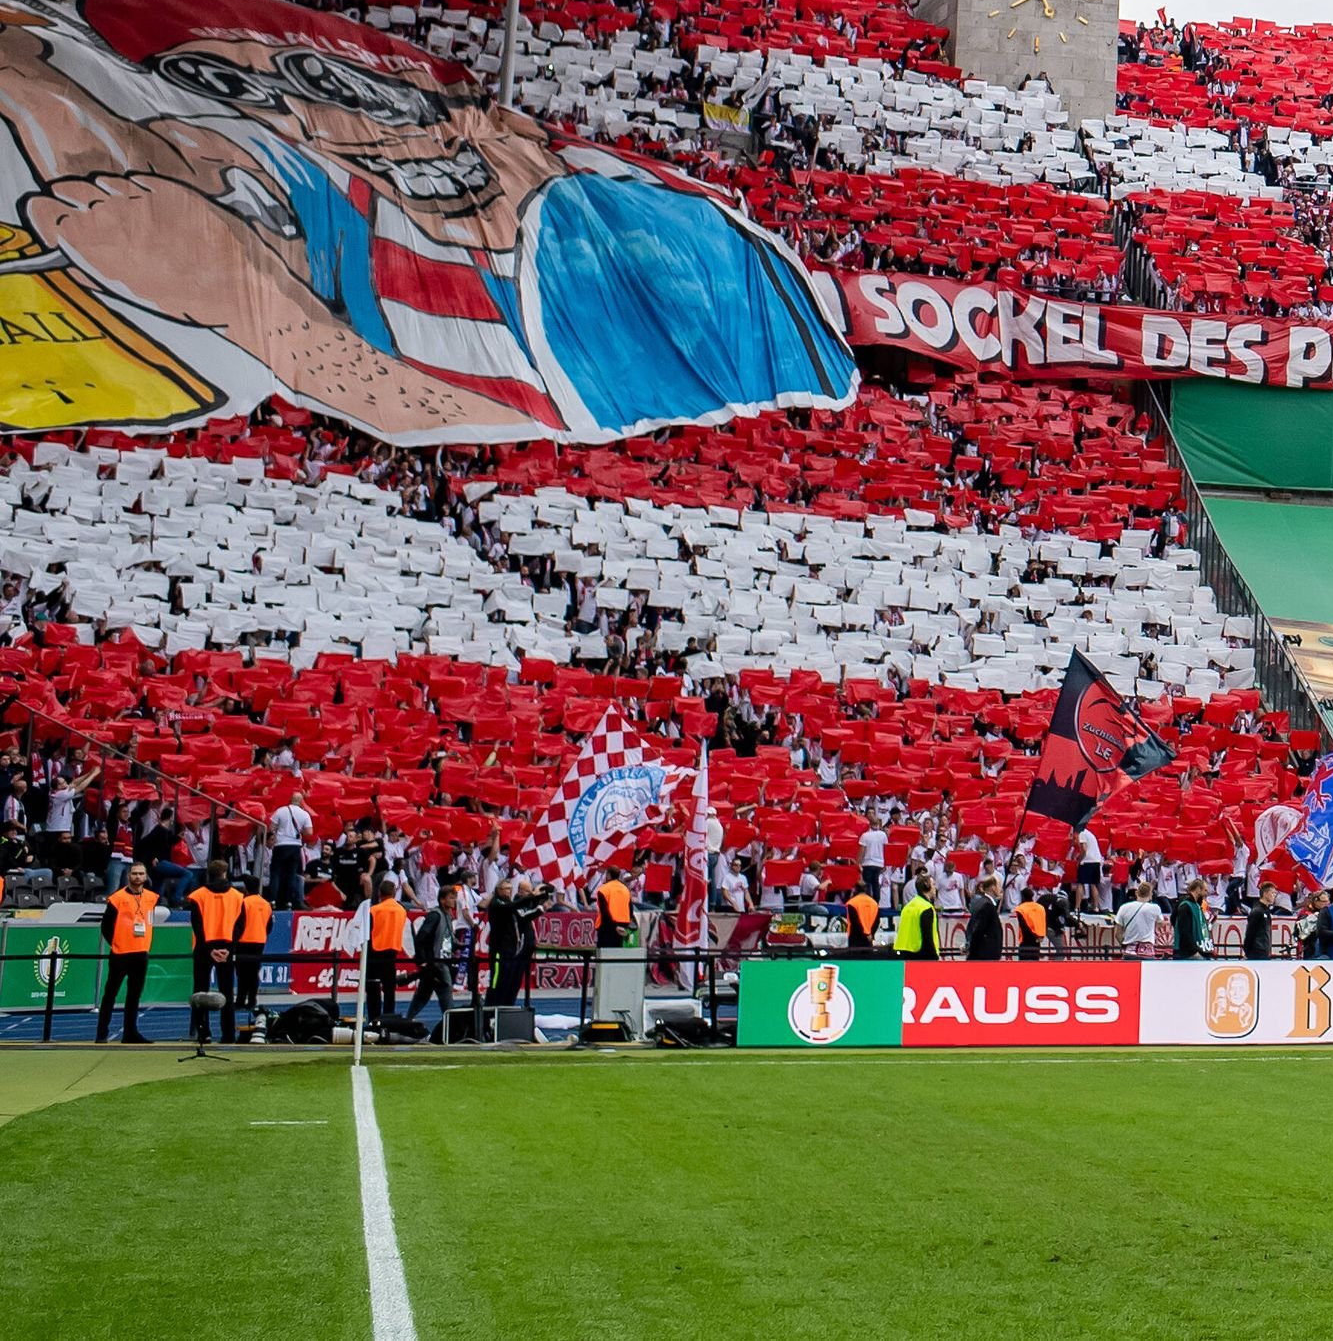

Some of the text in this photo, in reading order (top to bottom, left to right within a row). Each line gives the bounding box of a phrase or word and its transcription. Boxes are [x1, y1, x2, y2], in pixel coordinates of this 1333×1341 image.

[0, 311, 107, 345] ALL
[859, 274, 1120, 367] SOCKEL
[1142, 314, 1268, 383] DES
